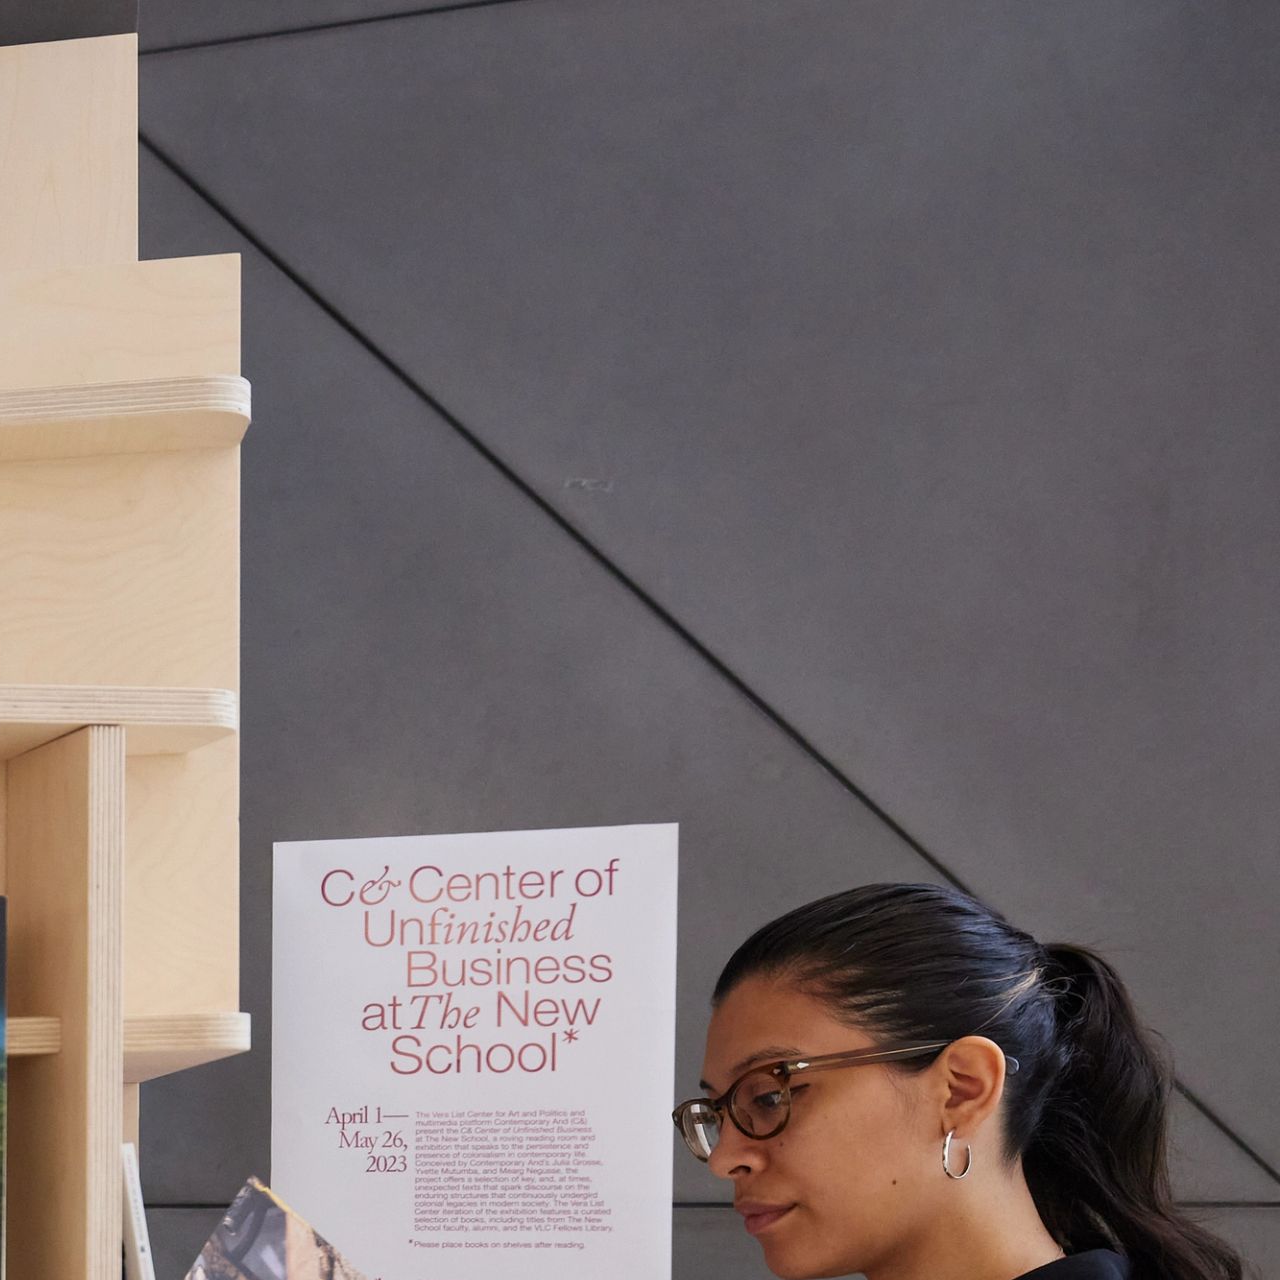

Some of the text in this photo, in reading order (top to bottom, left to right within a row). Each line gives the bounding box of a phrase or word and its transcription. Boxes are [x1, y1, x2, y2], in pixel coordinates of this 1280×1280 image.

[408, 865, 565, 903] Center
[574, 858, 621, 897] of
[363, 903, 578, 948] Unfinished
[406, 948, 613, 988] Business
[361, 990, 602, 1032] at The New
[325, 1106, 368, 1129] April
[338, 1130, 409, 1153] May 26,
[365, 1155, 408, 1174] 2023
[442, 1241, 463, 1250] place
[465, 1240, 490, 1249] books
[503, 1240, 533, 1249] shelves
[534, 1240, 553, 1249] after
